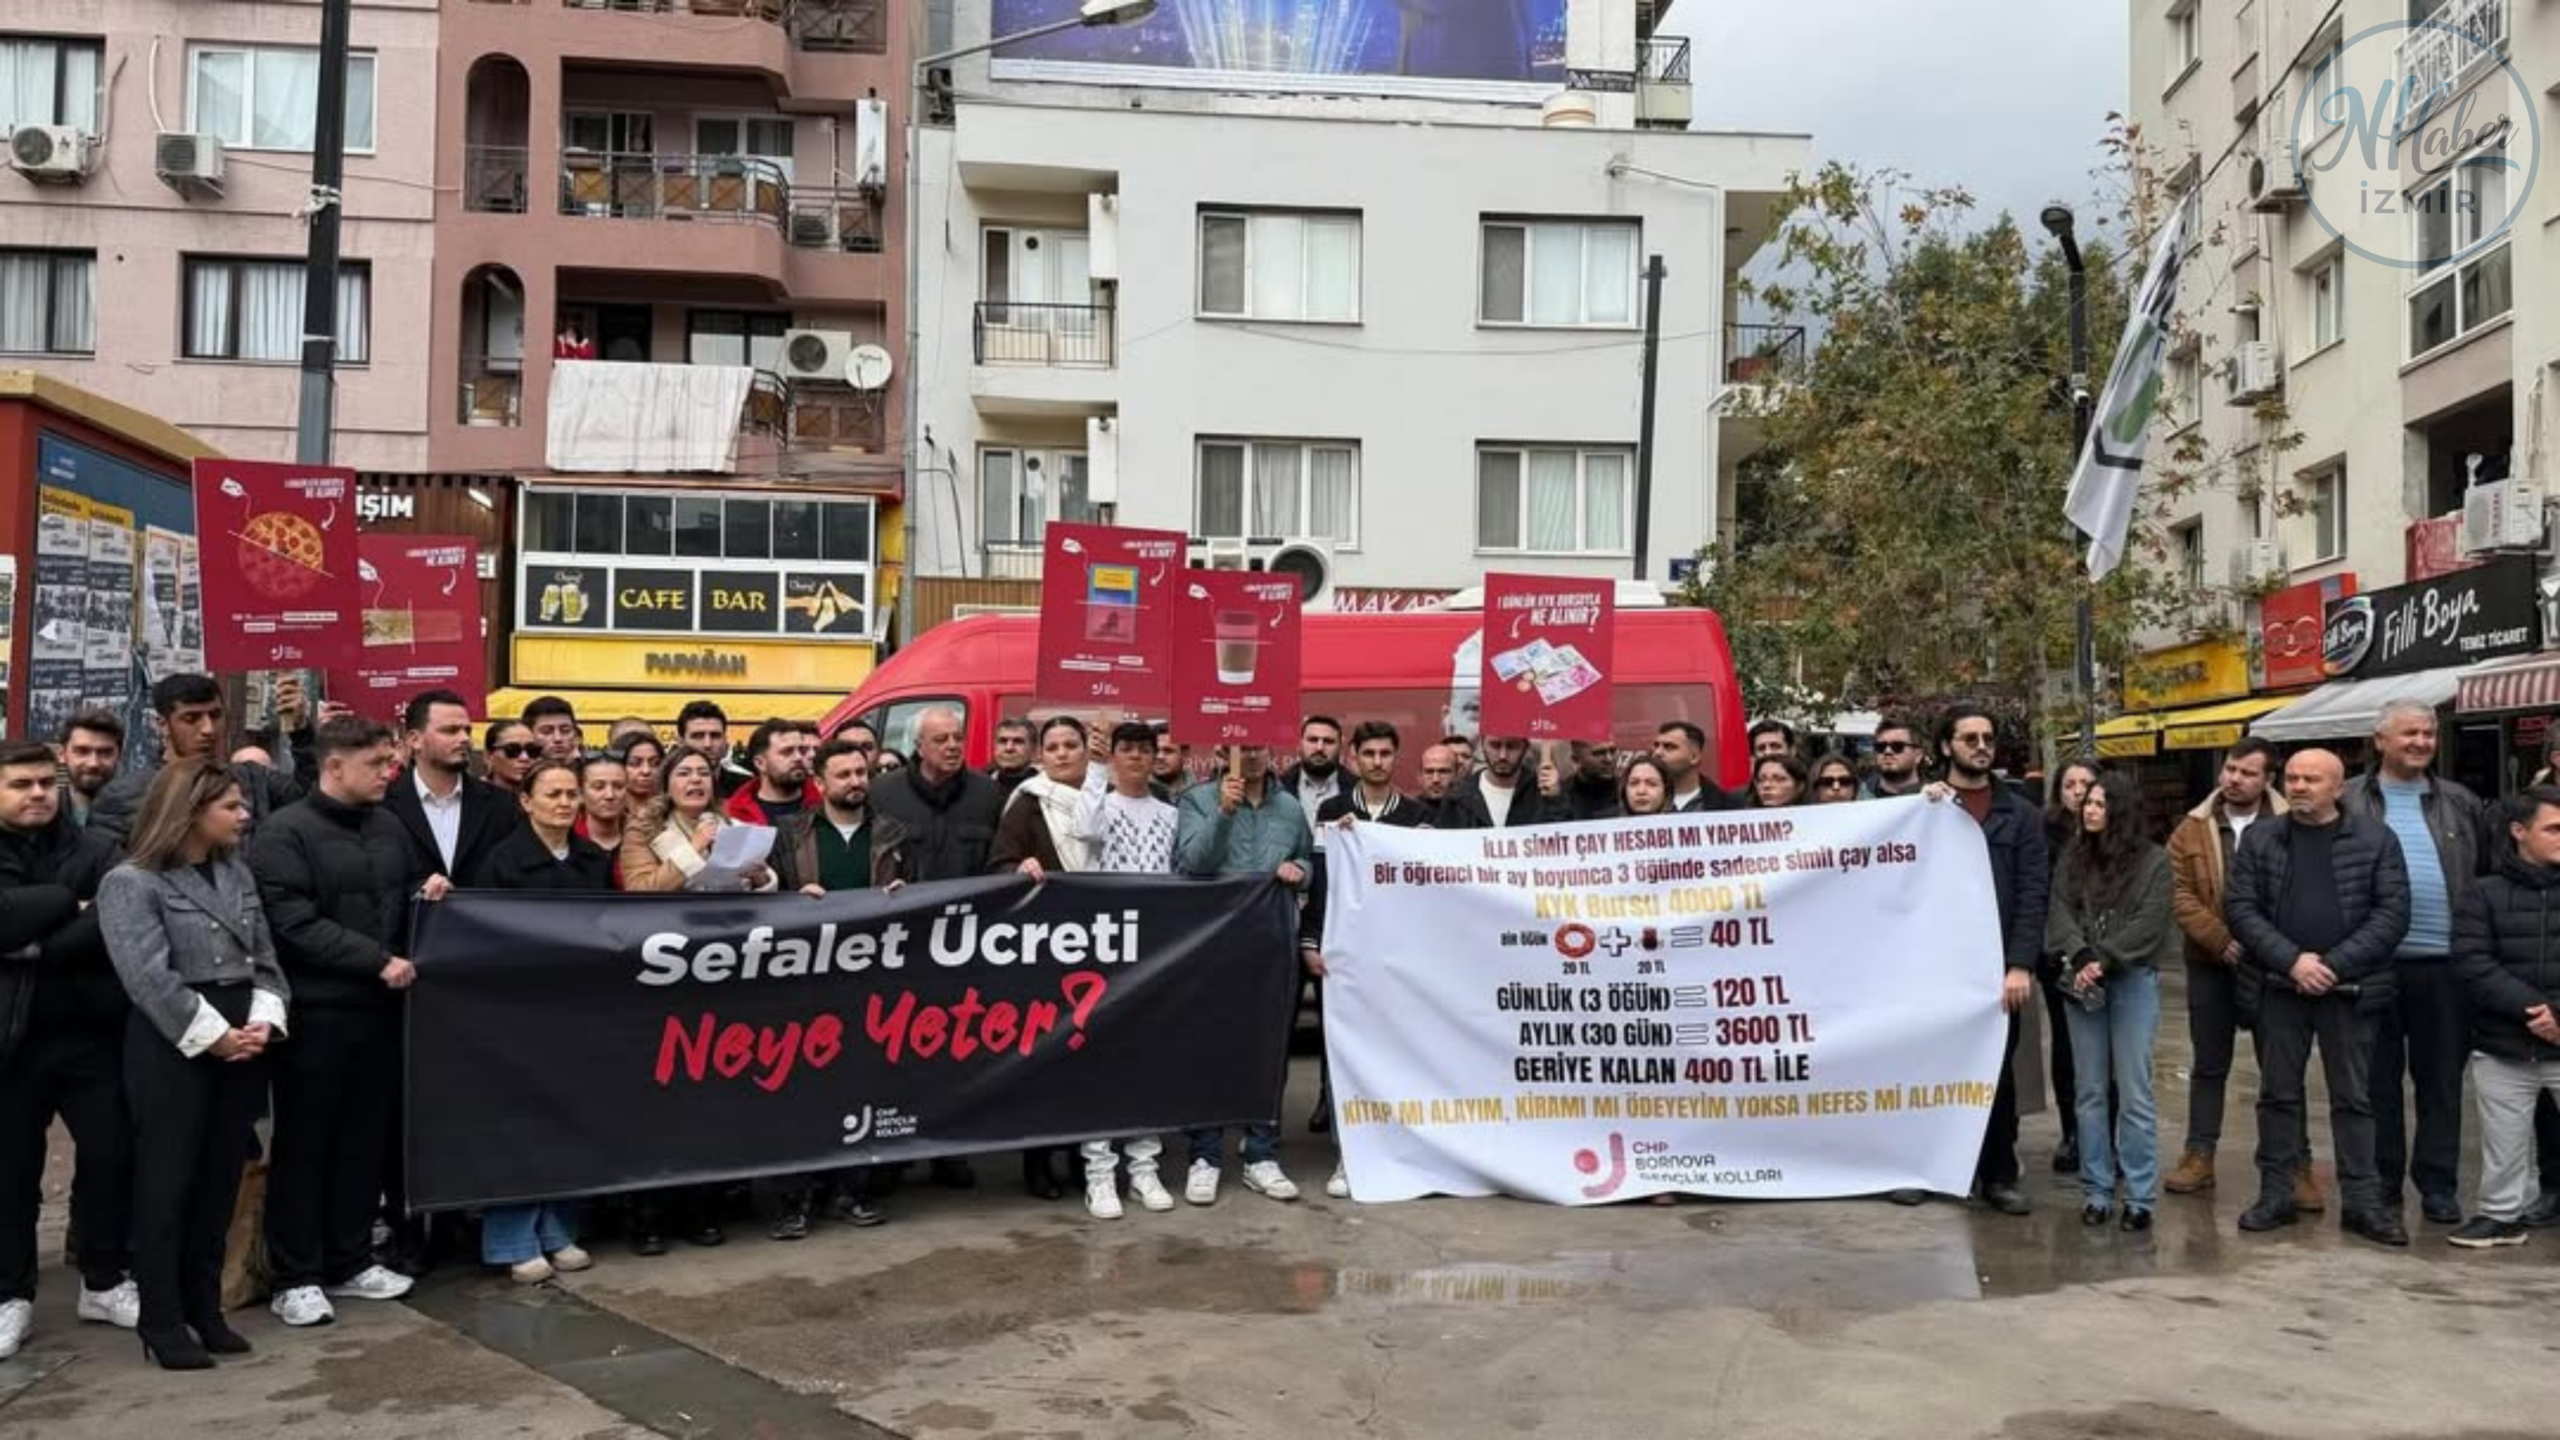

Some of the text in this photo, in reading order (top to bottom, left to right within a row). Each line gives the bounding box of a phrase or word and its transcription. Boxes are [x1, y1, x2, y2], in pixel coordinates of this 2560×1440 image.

[620, 589, 767, 611] CAFE BAR
[1530, 606, 1600, 633] NE ALINIR?
[2382, 588, 2481, 663] Filli Boya
[2488, 626, 2528, 648] TİCARET
[1483, 821, 1794, 861] İLLA SİMİT ÇAY HESABI MI YAPALIM?
[1374, 862, 1398, 885] Bir
[1403, 862, 1473, 887] öğrenci
[1507, 868, 1528, 887] ay
[1533, 864, 1613, 889] boyunca
[1617, 864, 1630, 884] 3
[1635, 857, 1705, 884] öğünde
[1710, 854, 1780, 878] sadece
[1786, 848, 1834, 870] simit
[1838, 847, 1872, 874] çay
[1876, 841, 1916, 863] alsa
[1536, 882, 1767, 918] KYK Bursu 4000 TL
[636, 904, 1138, 986] Sefalet Ücreti
[1500, 931, 1518, 946] BİR
[1710, 917, 1774, 947] 40 TL
[1562, 961, 1591, 975] 20 TL
[1637, 959, 1666, 974] 20 TL
[1497, 982, 1671, 1012] GÜNLÜK (3 ÖĞÜN)
[1713, 976, 1790, 1008] 120 TL
[655, 970, 1109, 1092] Neye Yeter?
[1519, 1018, 1672, 1046] AYLIK (30 GÜN)
[1715, 1014, 1814, 1046] 3600 TL
[1514, 1049, 1810, 1084] GERİYE KALAN 400 TL İLE
[1343, 1081, 1994, 1126] KİTAP MI ALAYIM, KİRAMI MI ÖDEYEYİM YOKSA NEFES Mİ ALAYIM?
[1632, 1140, 1669, 1155] CHP
[1634, 1154, 1716, 1170] BORNOVA
[1714, 1168, 1783, 1185] KOLLARI
